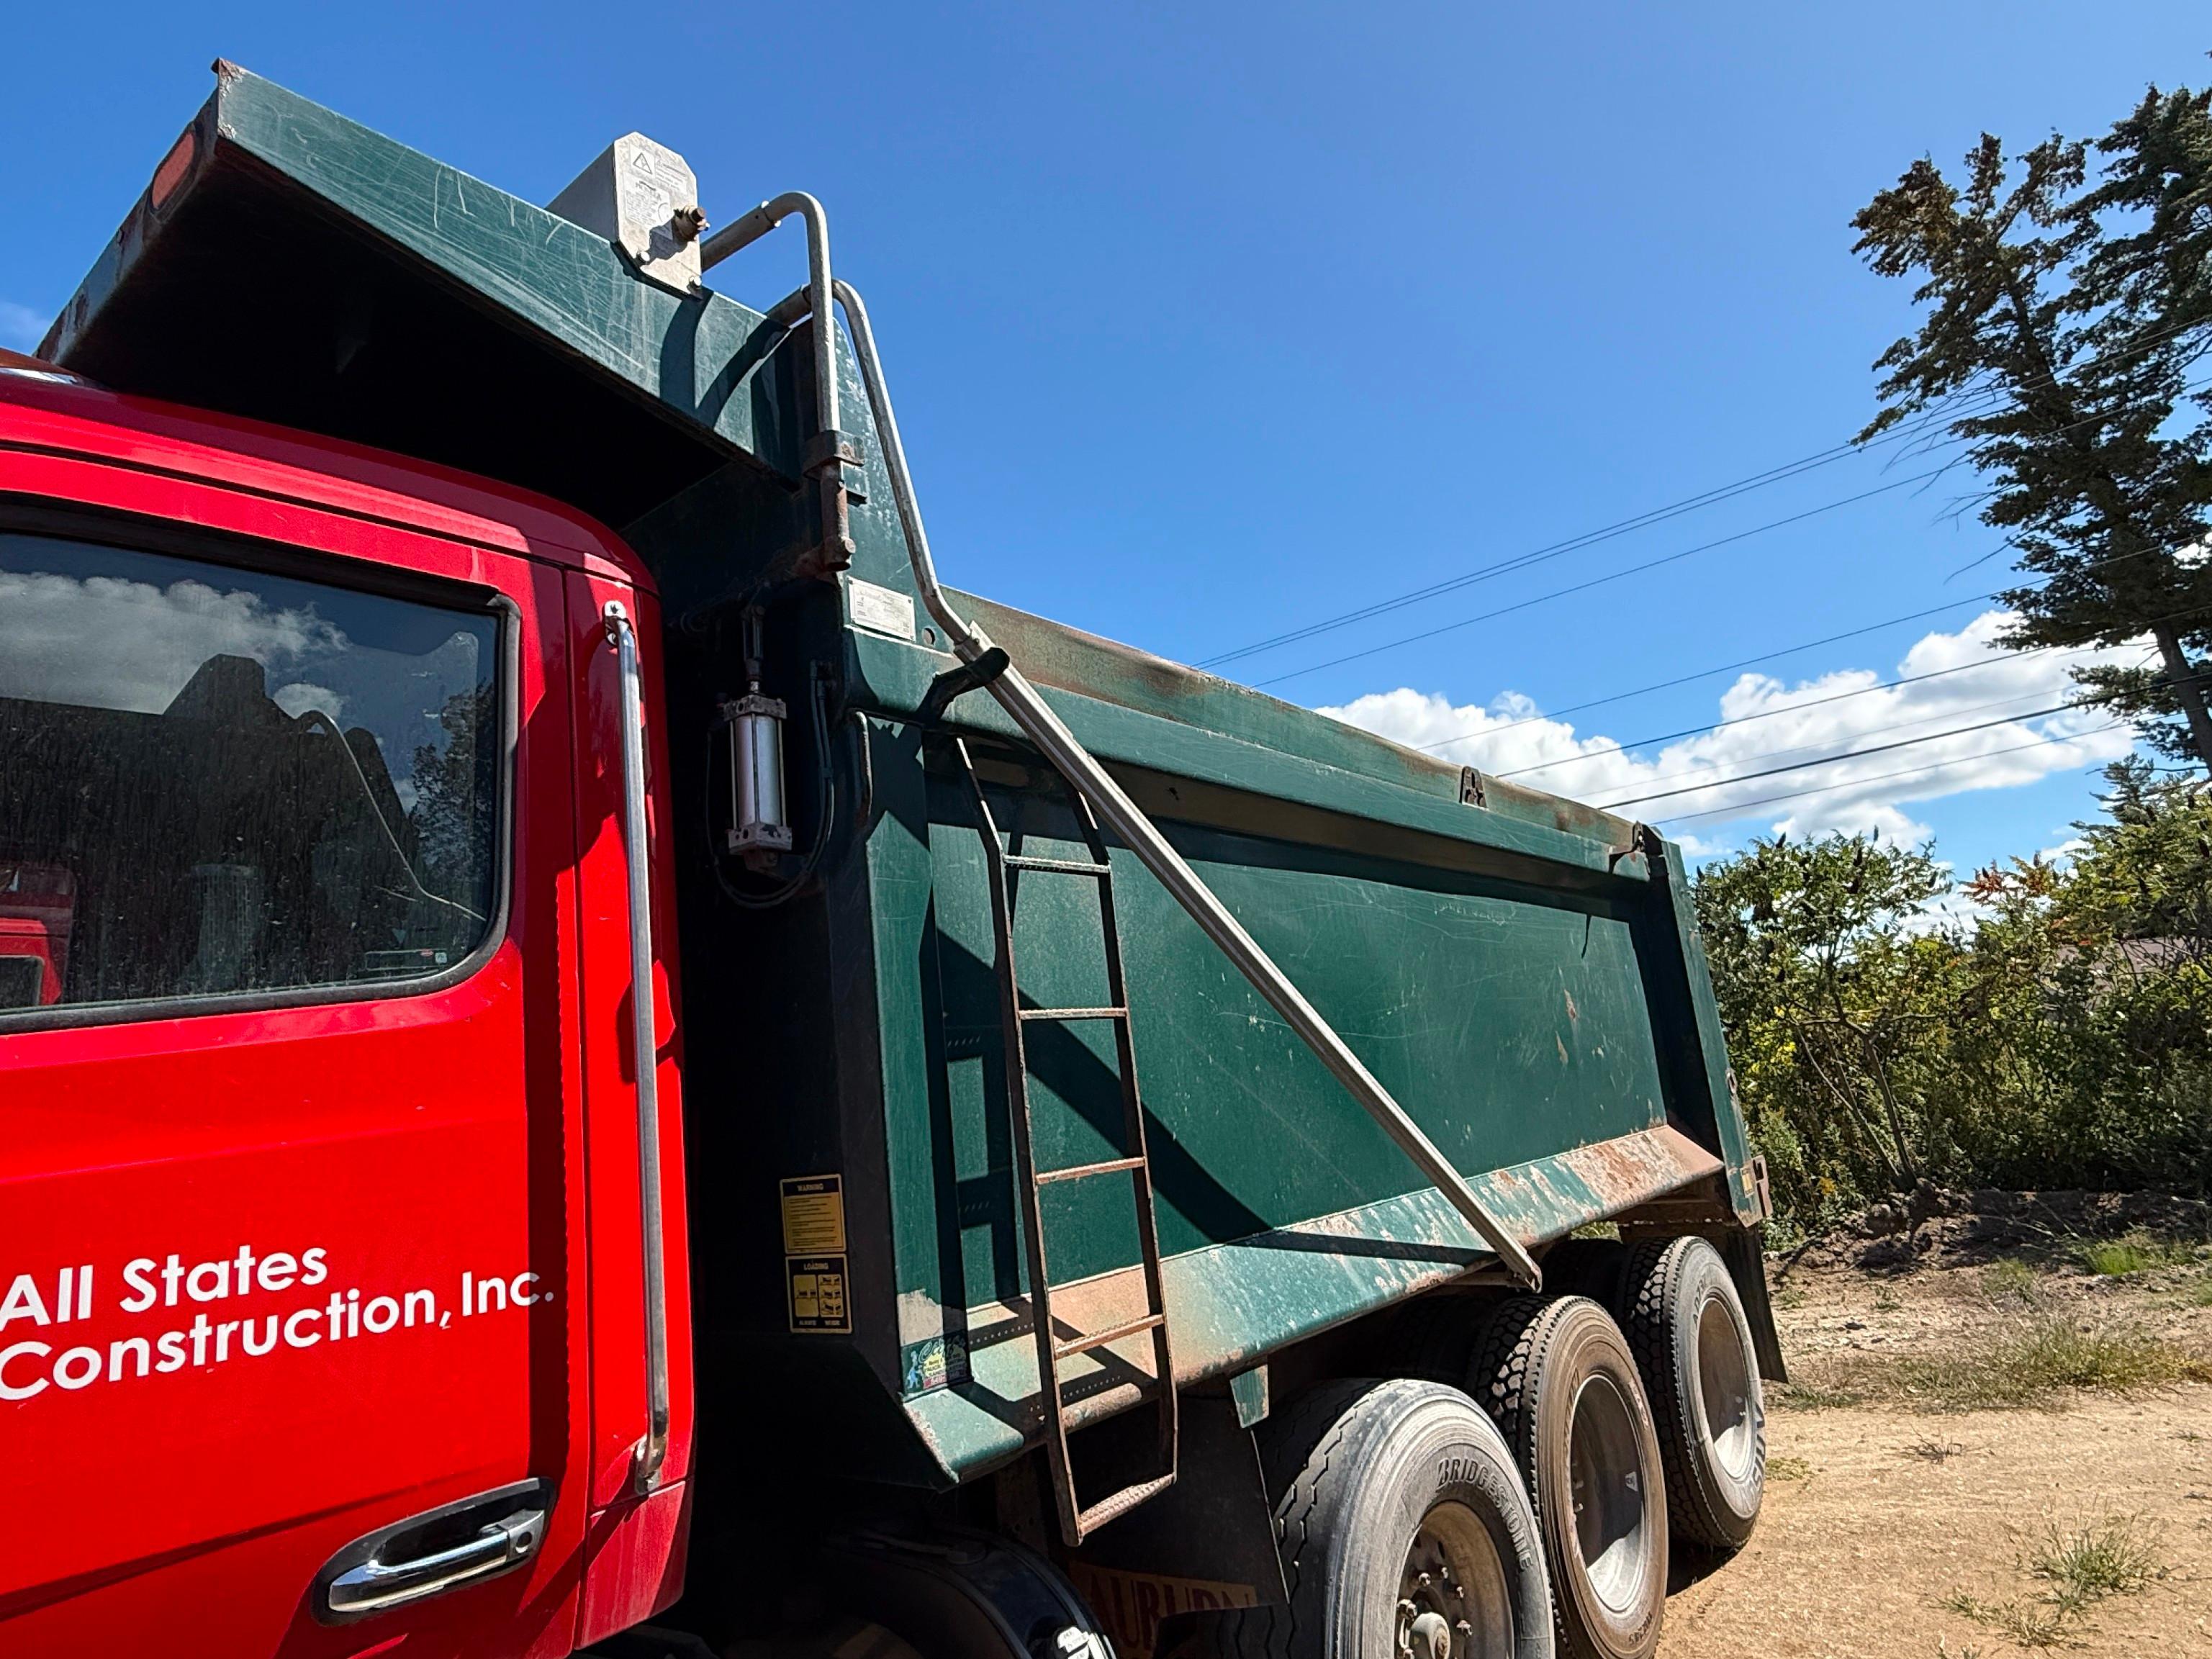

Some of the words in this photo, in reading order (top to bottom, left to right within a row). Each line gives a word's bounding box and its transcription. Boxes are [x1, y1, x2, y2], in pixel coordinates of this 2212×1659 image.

[0, 1265, 94, 1332] All
[119, 1244, 328, 1313] States
[462, 1271, 554, 1316] Inc.
[1436, 1457, 1534, 1570] BRIDGESTONE
